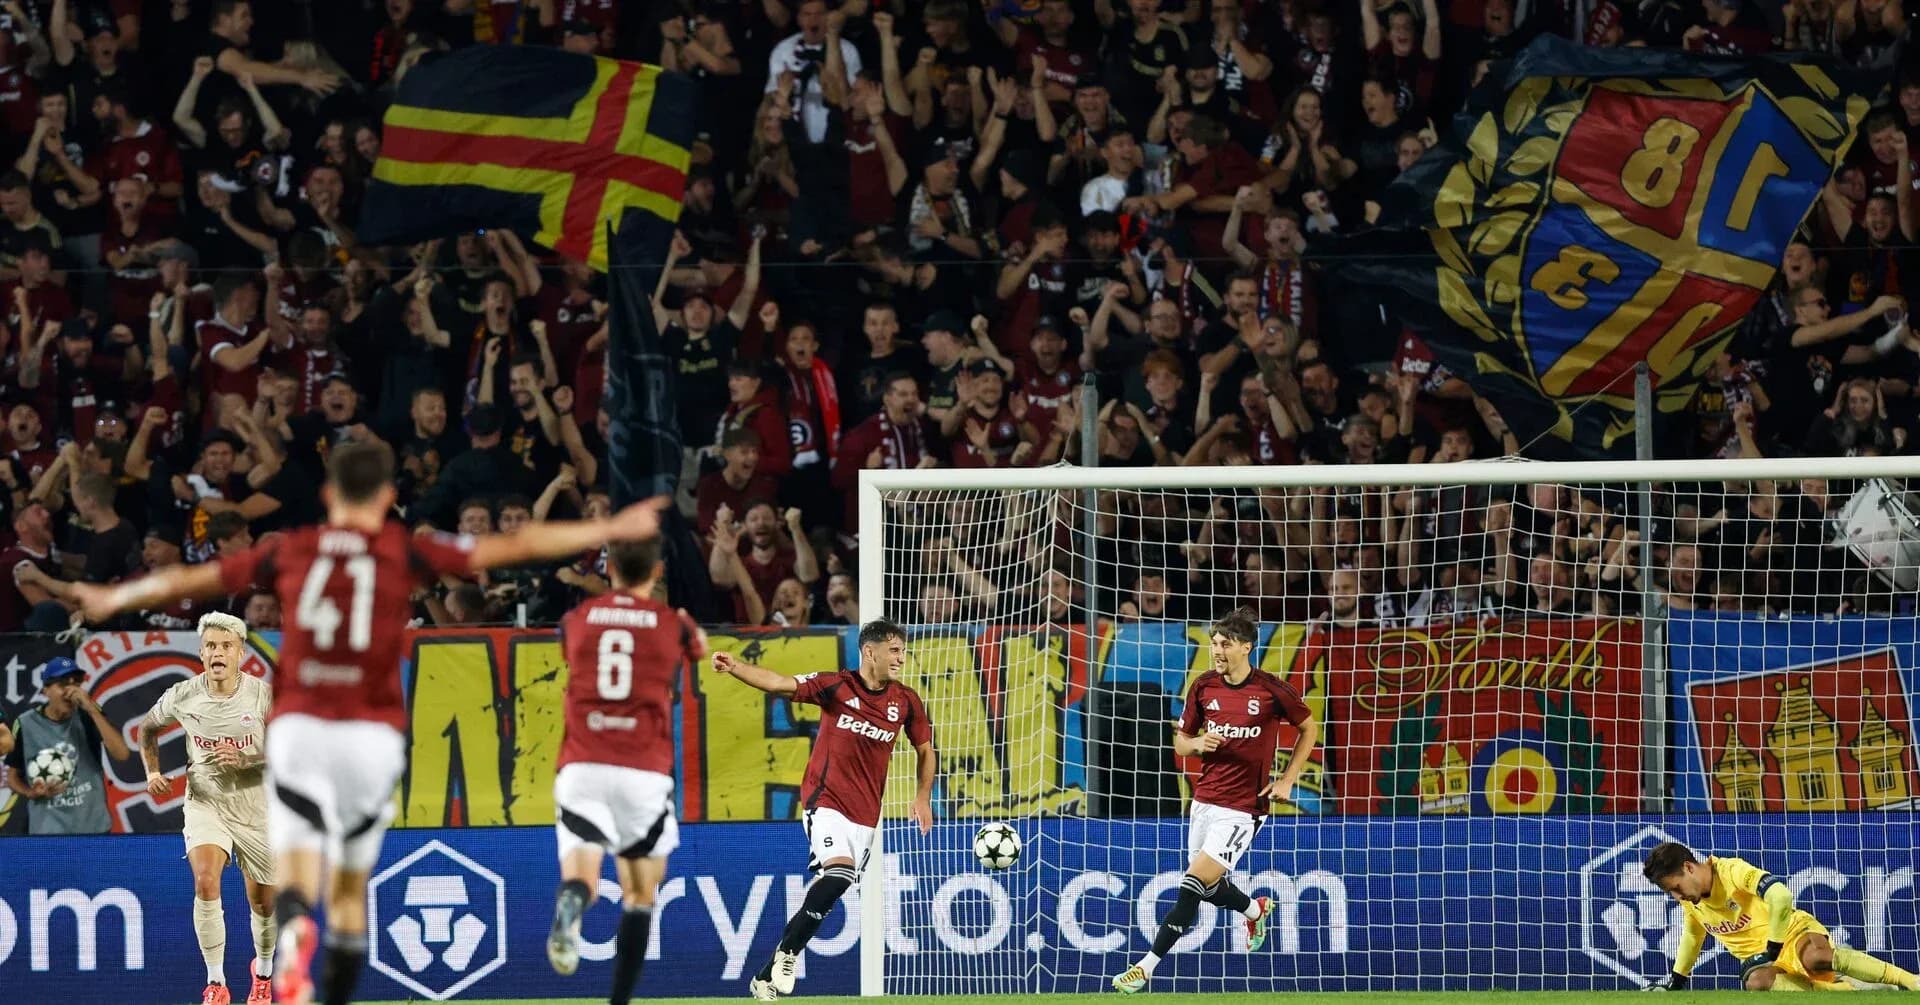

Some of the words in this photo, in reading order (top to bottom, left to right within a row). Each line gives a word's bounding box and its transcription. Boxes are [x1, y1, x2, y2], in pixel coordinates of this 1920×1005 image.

[296, 556, 376, 652] 41
[597, 629, 635, 700] 6
[836, 713, 895, 743] Betano
[1207, 720, 1262, 739] Betano
[1226, 824, 1248, 853] 14
[578, 853, 1349, 981] crypto.com
